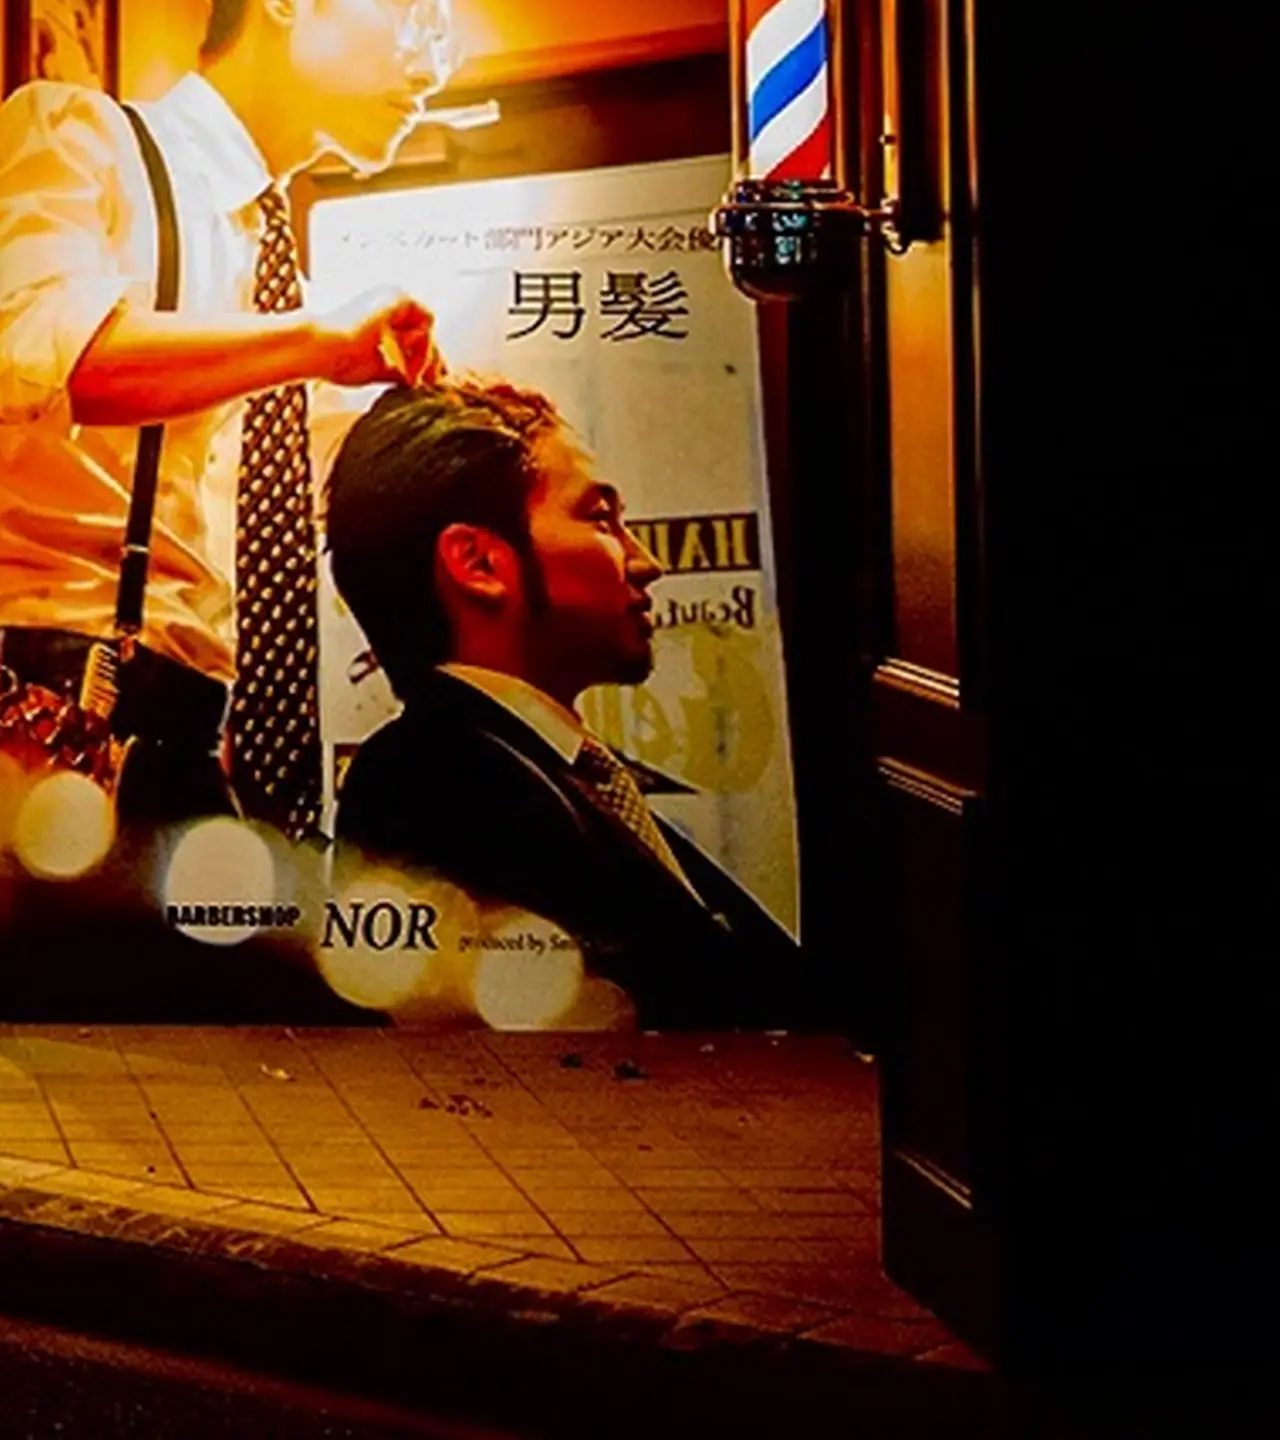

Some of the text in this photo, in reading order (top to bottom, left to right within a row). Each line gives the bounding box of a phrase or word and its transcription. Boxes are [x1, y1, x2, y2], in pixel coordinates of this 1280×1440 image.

[505, 269, 691, 342] 男髪
[167, 903, 301, 927] BARBERSHOP
[319, 901, 440, 951] NOR
